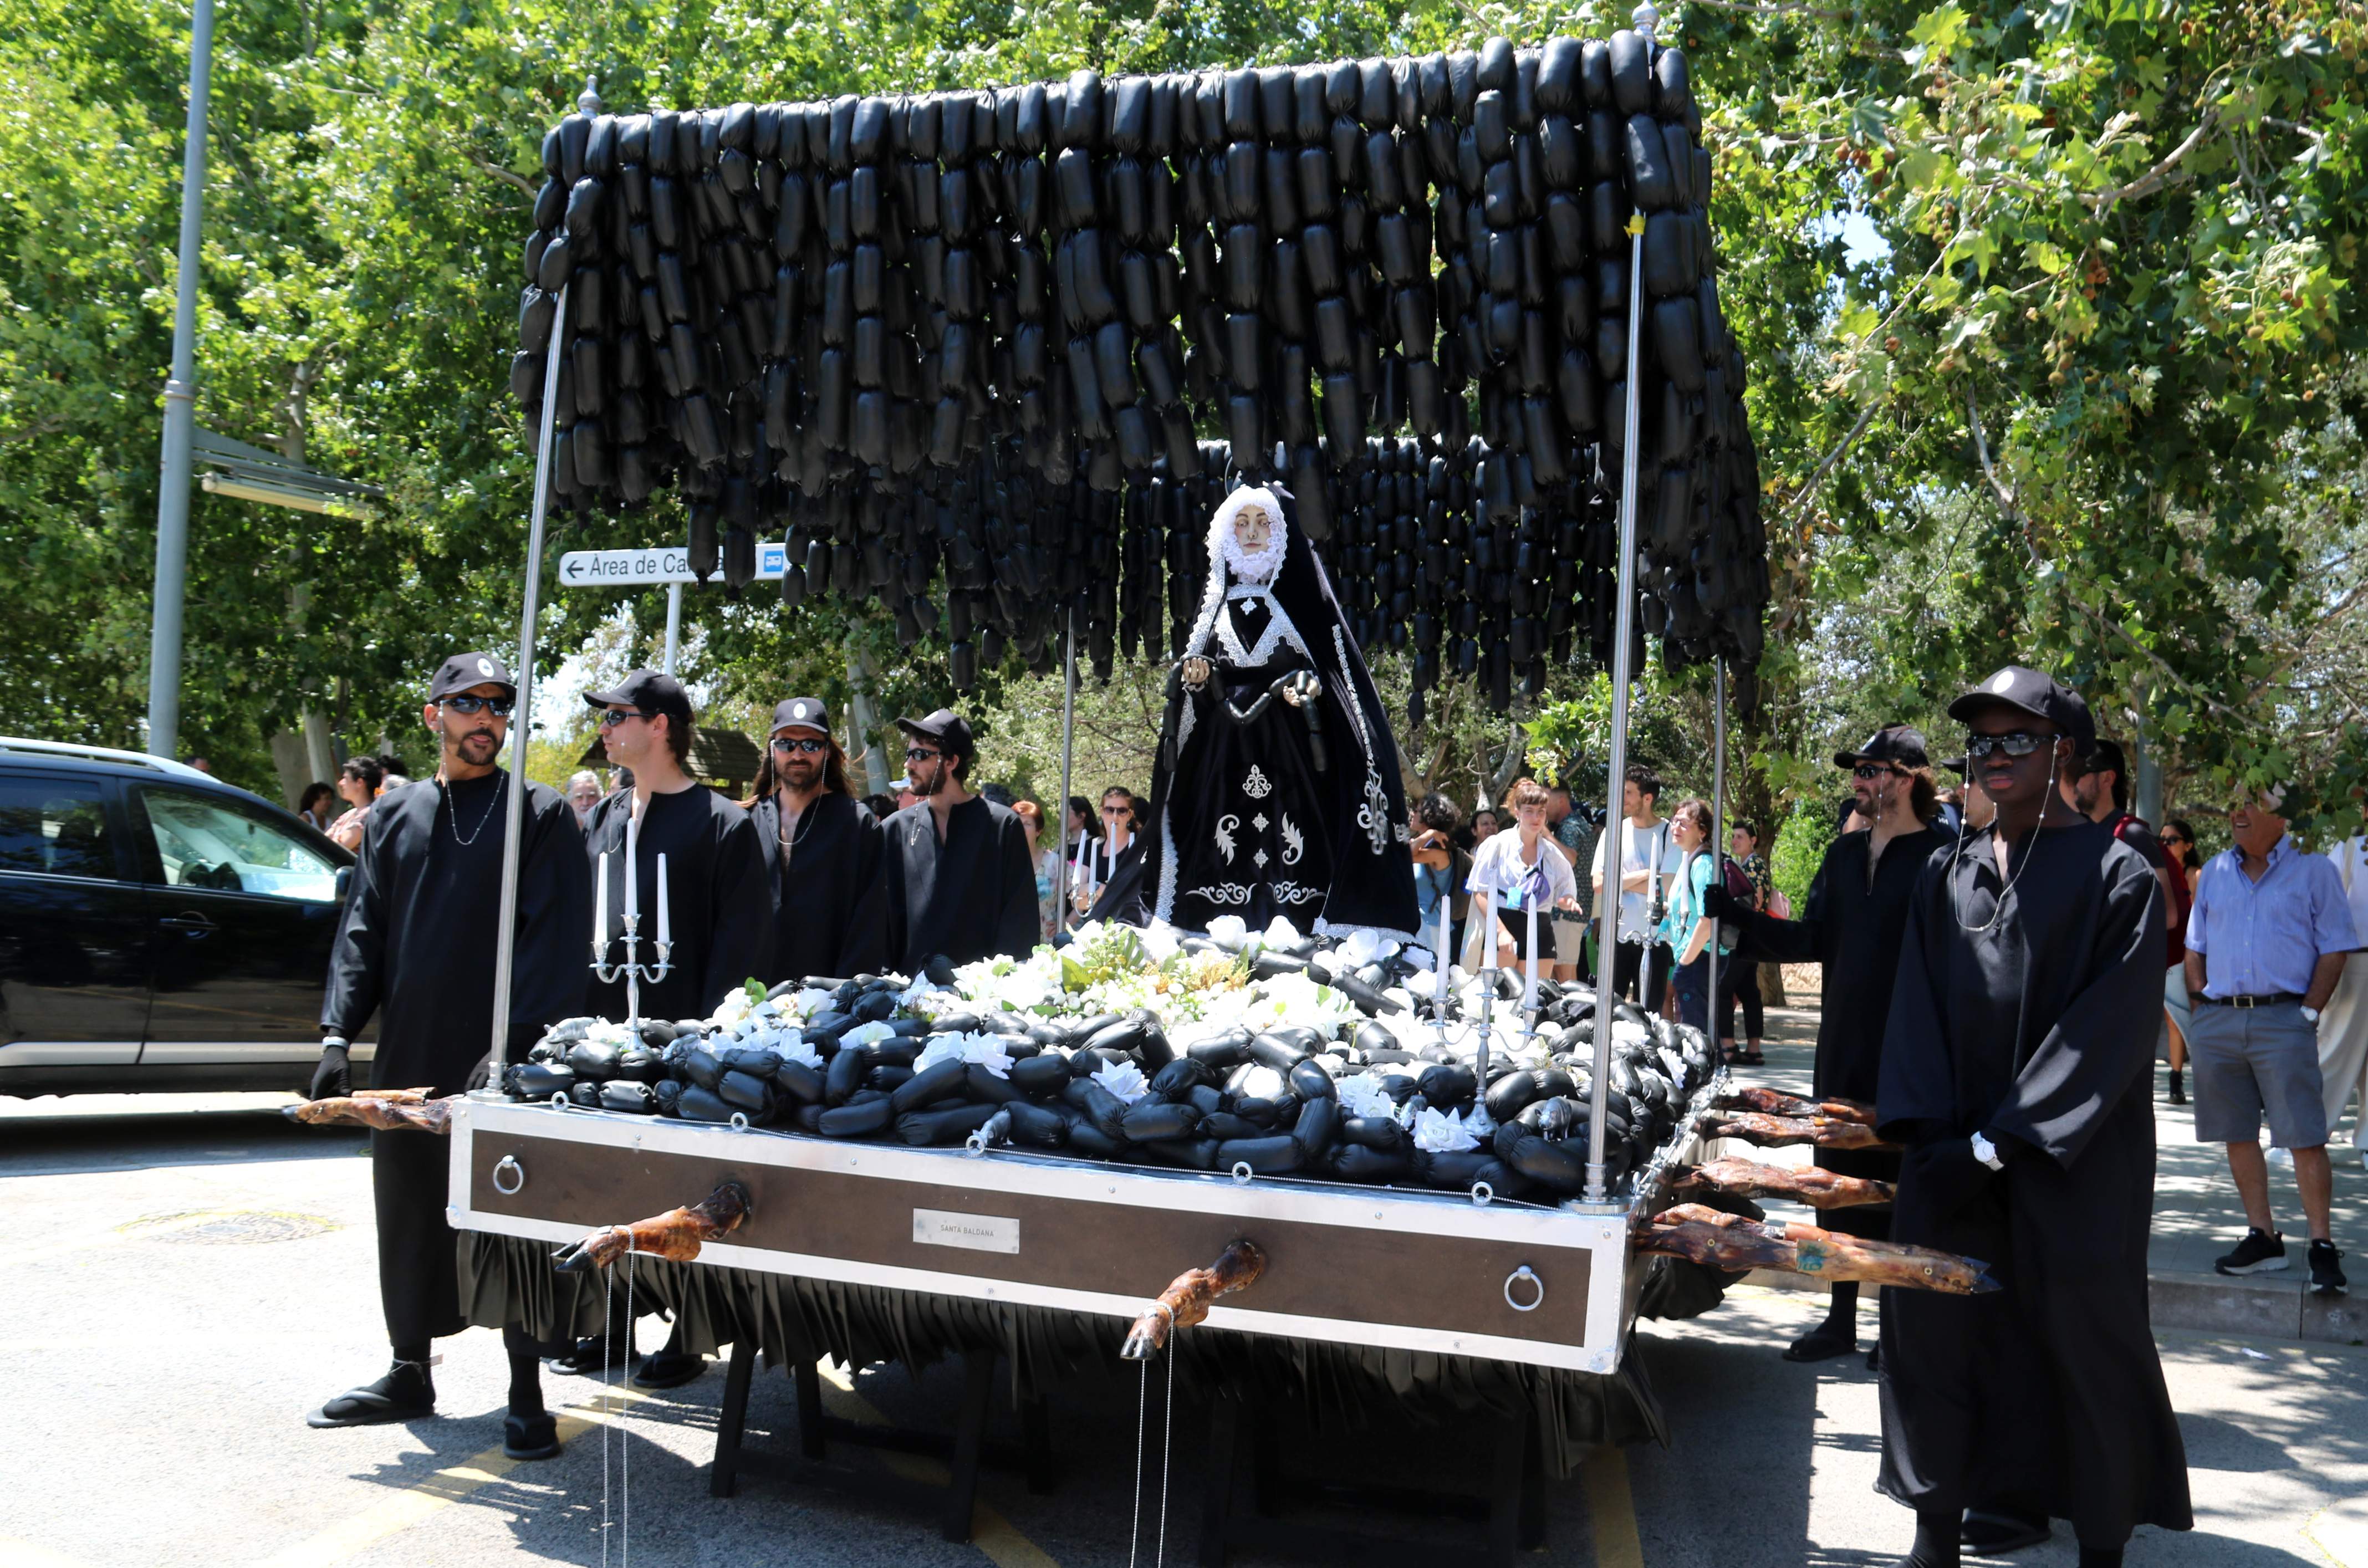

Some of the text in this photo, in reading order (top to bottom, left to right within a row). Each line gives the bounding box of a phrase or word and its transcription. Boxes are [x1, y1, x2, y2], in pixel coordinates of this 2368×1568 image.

[635, 555, 656, 574] de
[940, 1224, 994, 1237] SANTA BALDANA
